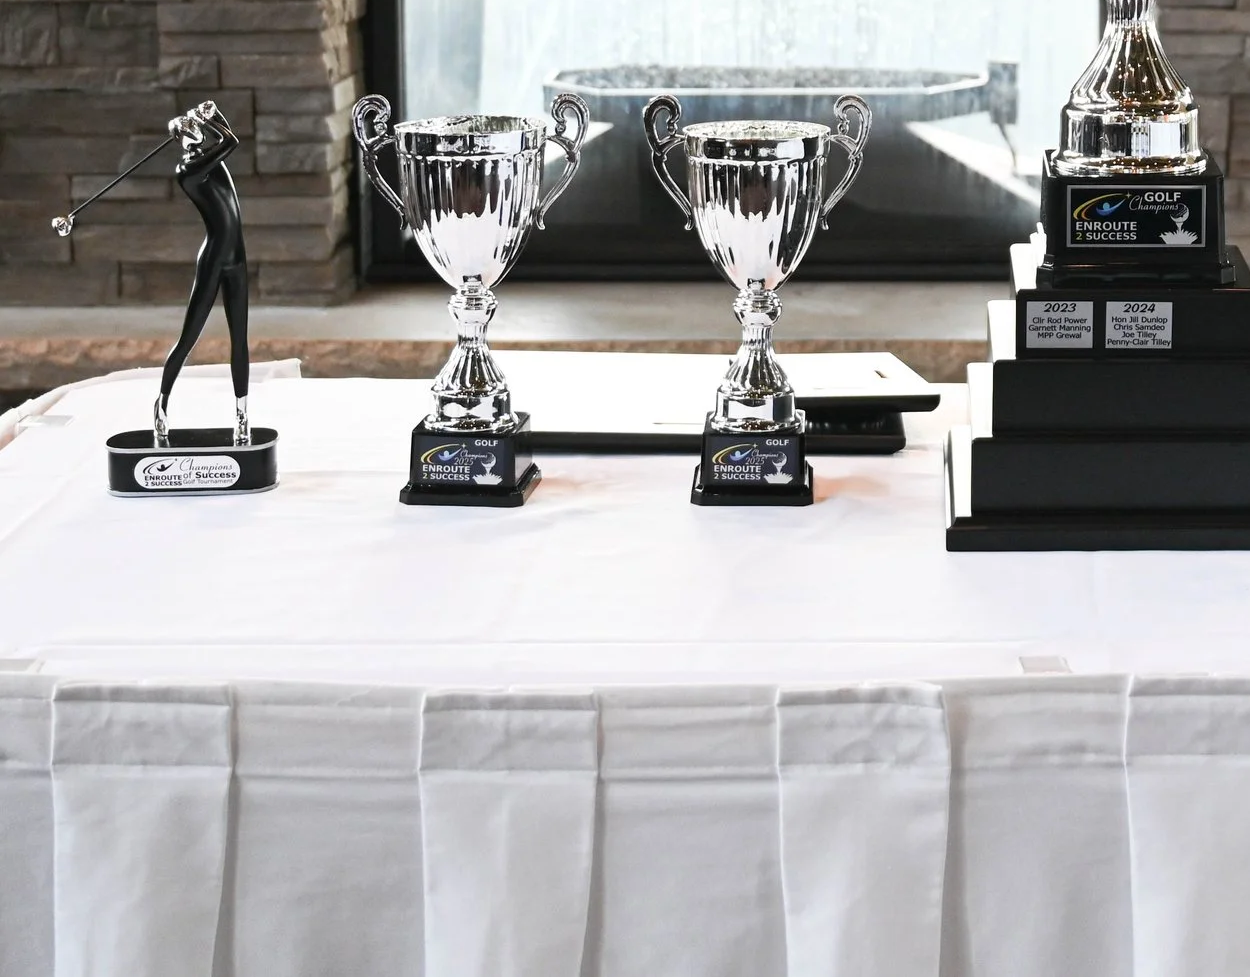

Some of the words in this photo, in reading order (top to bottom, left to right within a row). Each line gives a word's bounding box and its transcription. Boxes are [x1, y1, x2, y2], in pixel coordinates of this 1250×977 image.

[1144, 192, 1181, 202] GOLF
[1129, 195, 1179, 214] Champions
[1076, 222, 1137, 231] ENROUTE
[1076, 232, 1083, 240] 2
[1086, 232, 1137, 240] SUCCESS
[1044, 303, 1076, 312] 2023
[1123, 303, 1156, 312] 2024
[1142, 316, 1168, 324] Dunlop
[1137, 331, 1157, 339] Tilley
[1107, 338, 1149, 346] Penny-Clair
[454, 457, 474, 466] 2025
[745, 456, 765, 465] 2025
[179, 458, 233, 474] Champions
[422, 464, 470, 473] ENROUTE
[195, 471, 236, 479] Success
